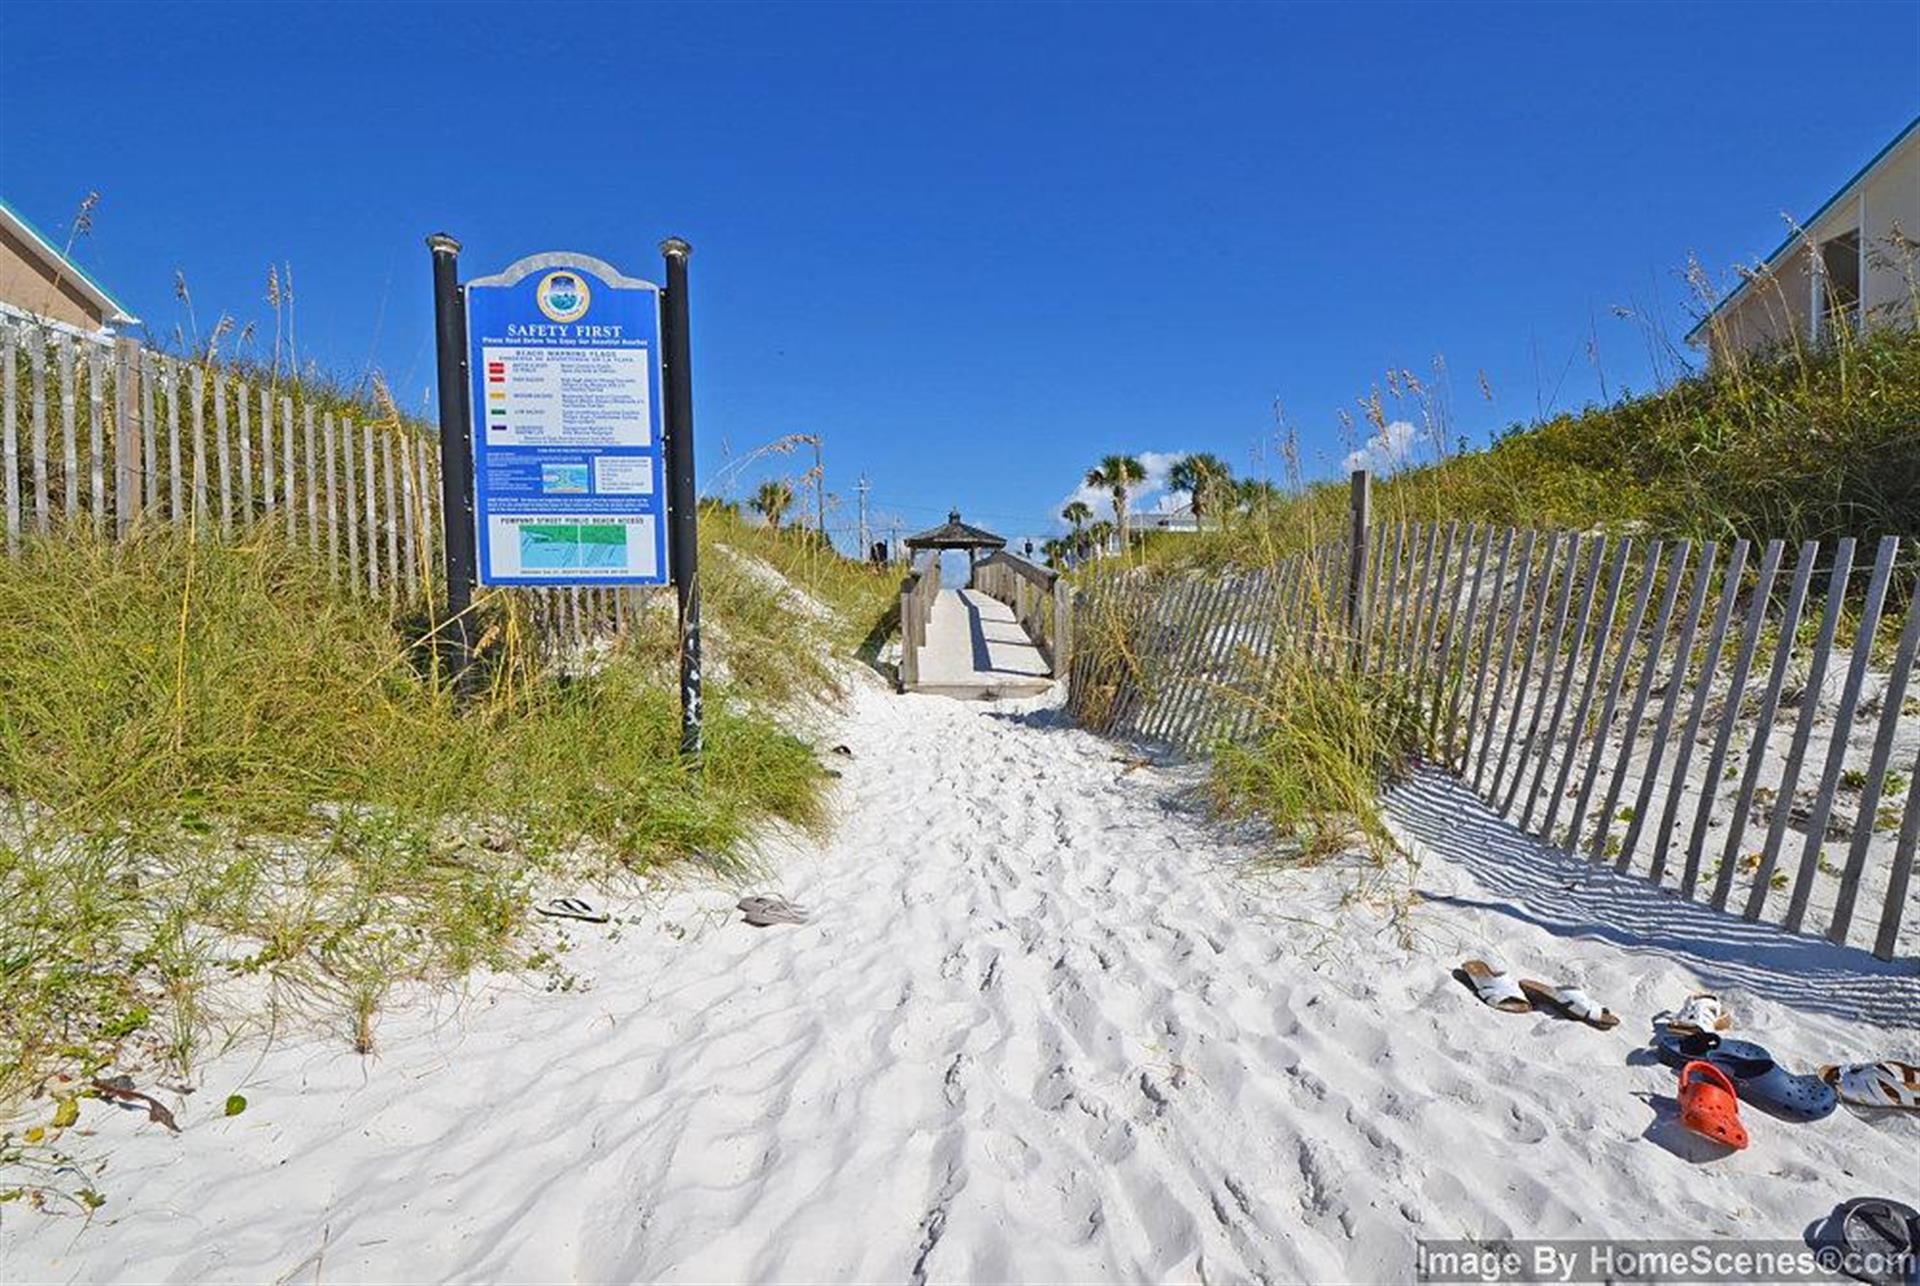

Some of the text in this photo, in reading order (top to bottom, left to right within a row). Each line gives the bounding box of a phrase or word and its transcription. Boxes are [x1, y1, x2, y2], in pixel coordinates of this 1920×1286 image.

[507, 323, 622, 338] SAFETY FIRST
[559, 338, 577, 346] Enjoy
[565, 517, 589, 525] PUBLIC
[593, 517, 615, 525] BEACH
